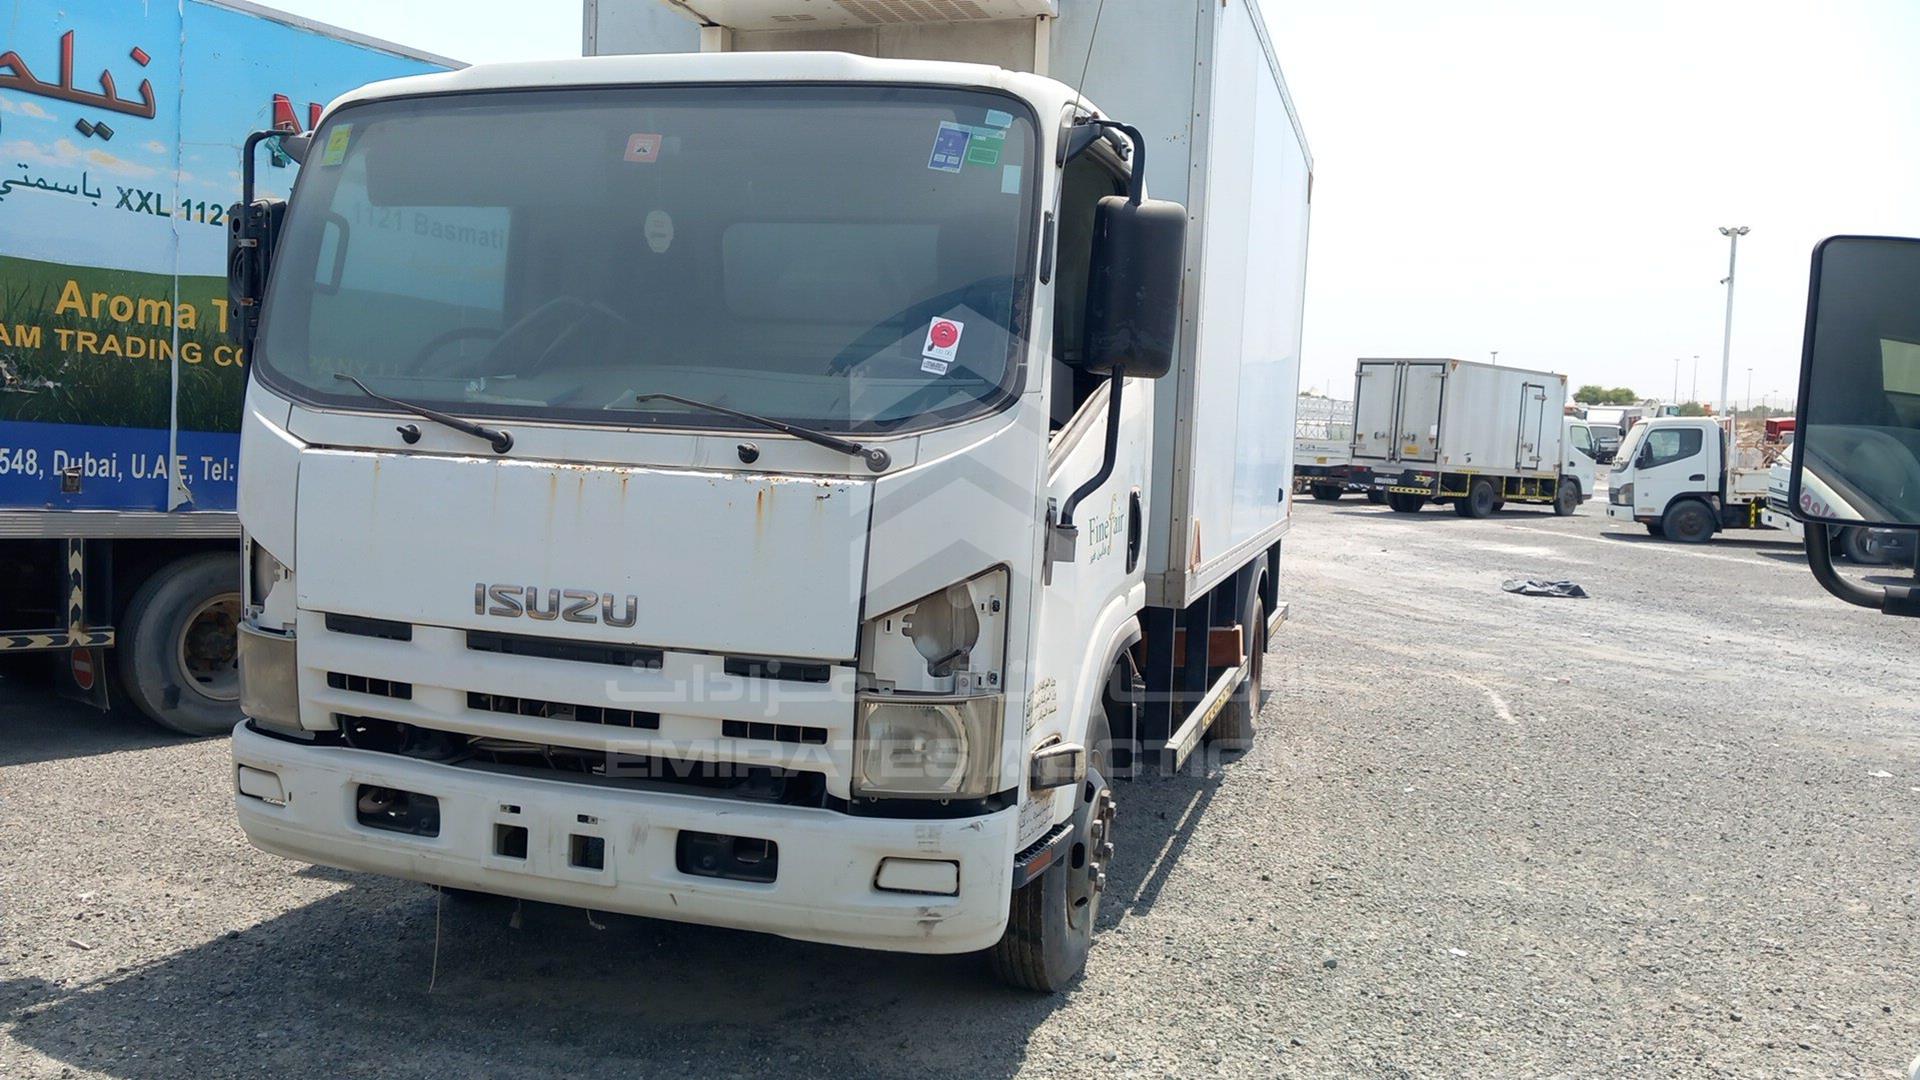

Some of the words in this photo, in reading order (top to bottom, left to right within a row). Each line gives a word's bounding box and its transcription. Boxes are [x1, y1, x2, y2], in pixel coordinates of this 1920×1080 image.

[115, 185, 171, 218] XXL
[181, 198, 231, 227] 112
[54, 279, 197, 331] Aroma
[54, 327, 202, 365] TRADING
[53, 449, 122, 483] Dubai,
[200, 455, 235, 482] Tel:
[474, 582, 638, 629] ISUZU
